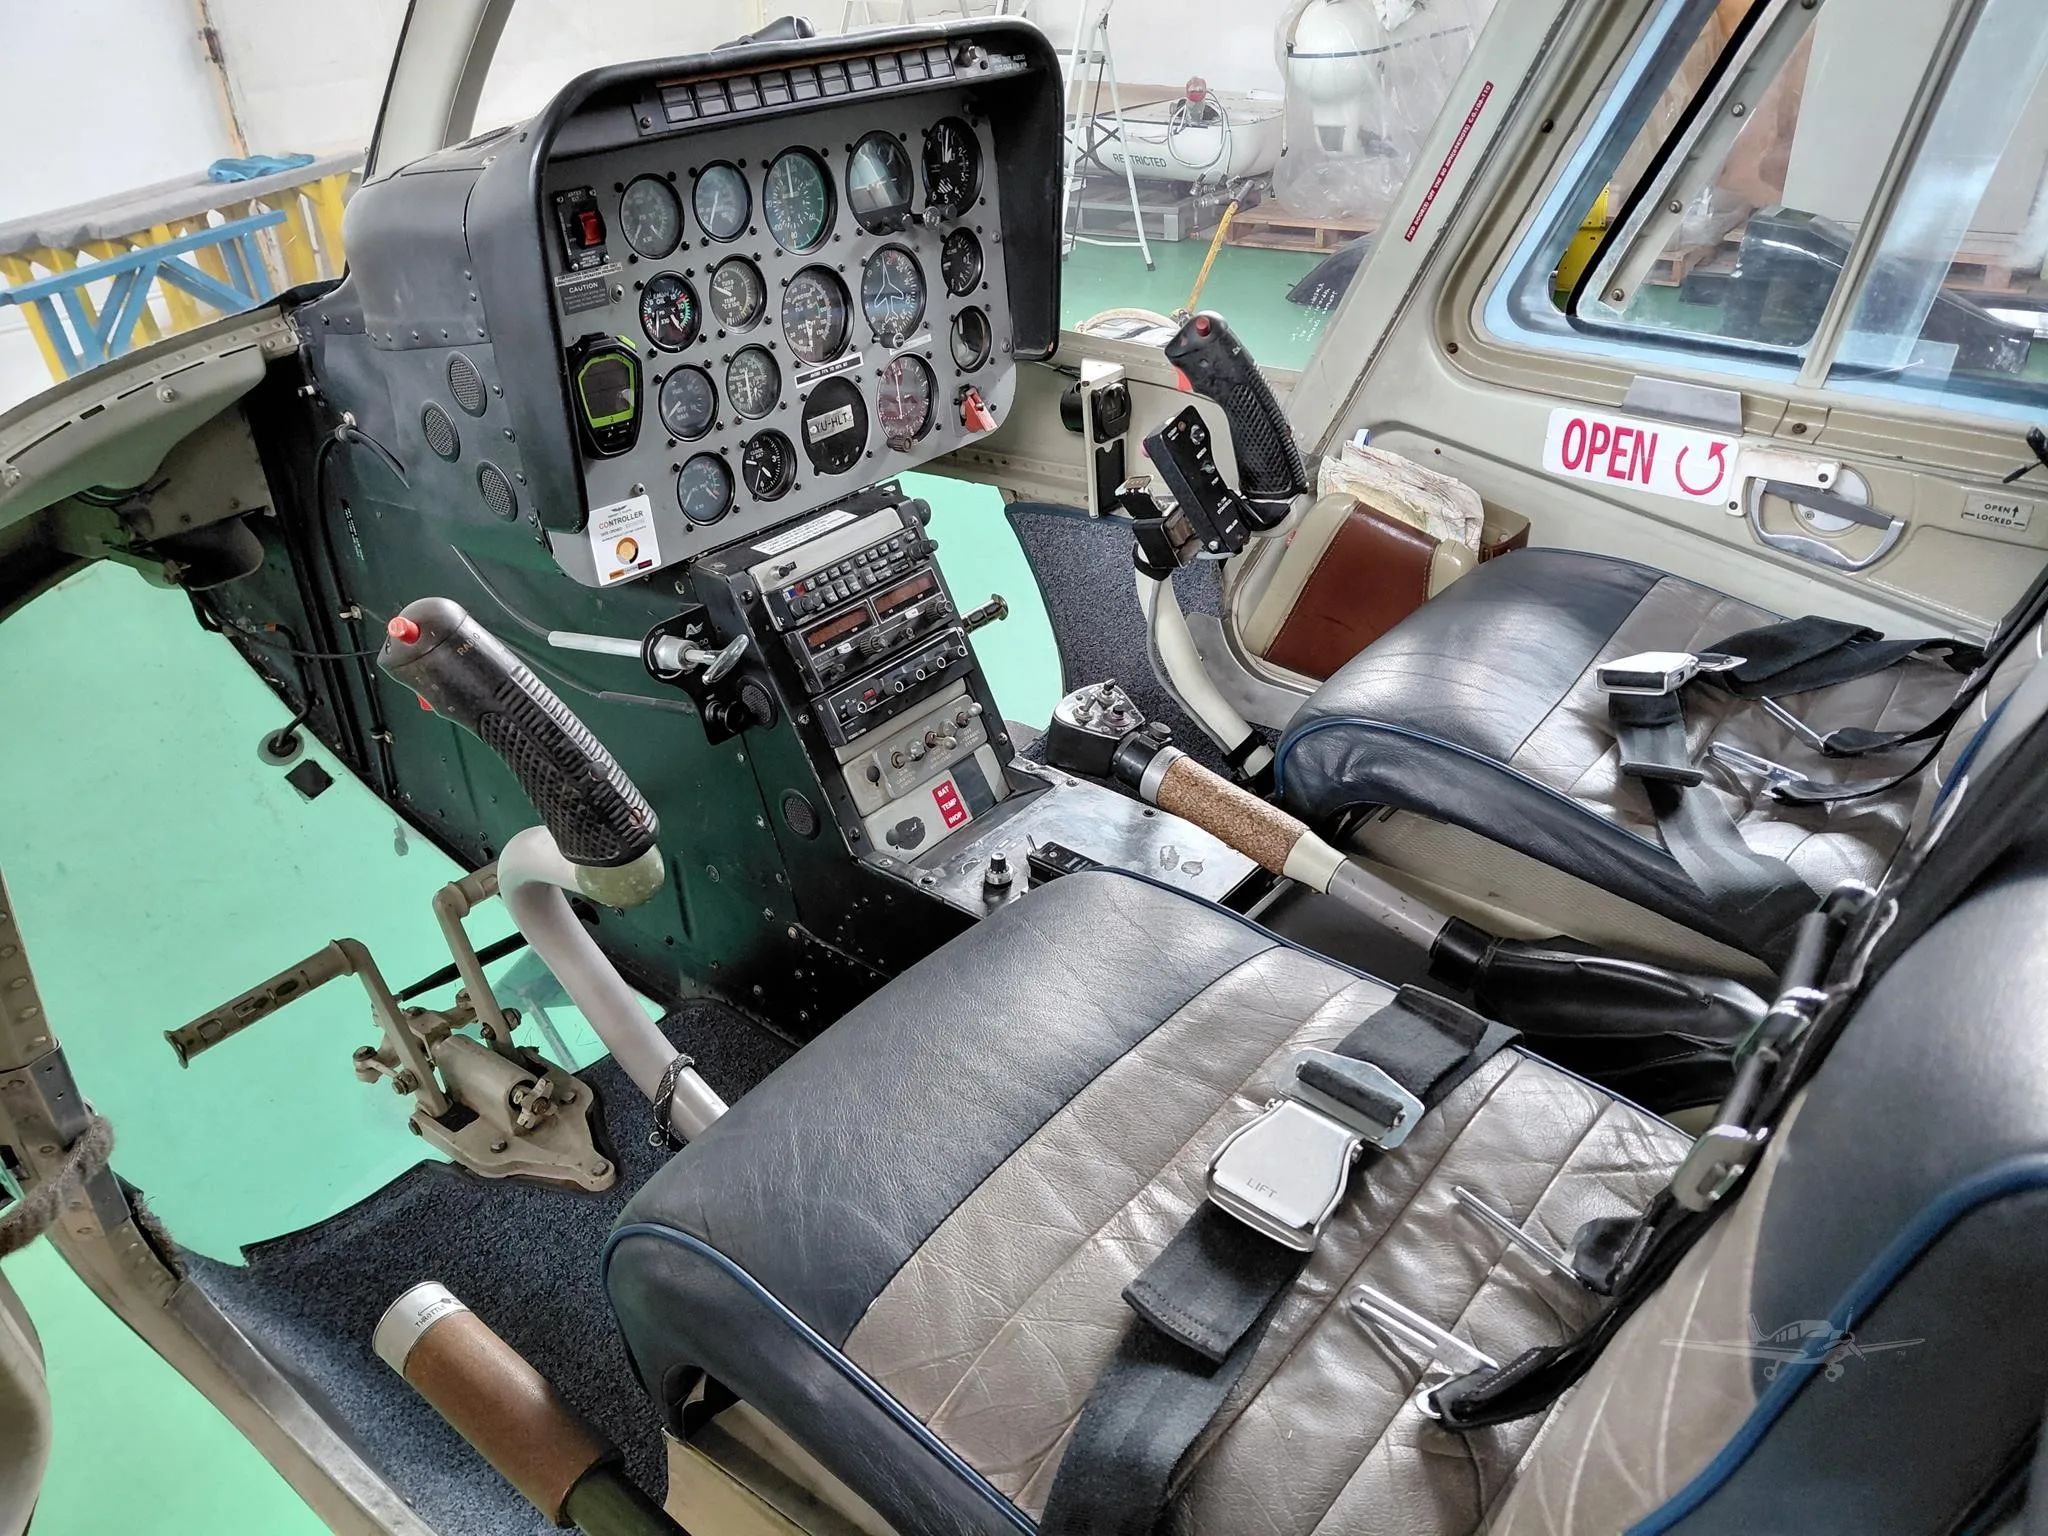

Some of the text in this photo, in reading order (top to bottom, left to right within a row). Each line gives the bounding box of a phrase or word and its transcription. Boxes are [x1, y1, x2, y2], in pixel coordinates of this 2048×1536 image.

[1112, 153, 1166, 168] RETRICTED
[961, 173, 965, 181] 3
[569, 282, 598, 294] CAUTION
[1562, 418, 1658, 484] OPEN
[1984, 504, 2011, 513] OPEN
[599, 510, 643, 529] CONTROLLER
[1976, 513, 2012, 525] LOCKED
[456, 632, 480, 656] RADIO
[937, 786, 949, 797] BAT
[941, 798, 957, 811] TEMP
[949, 812, 962, 824] INOP
[1246, 1178, 1278, 1199] LIFT
[415, 1304, 446, 1328] THROTTLE
